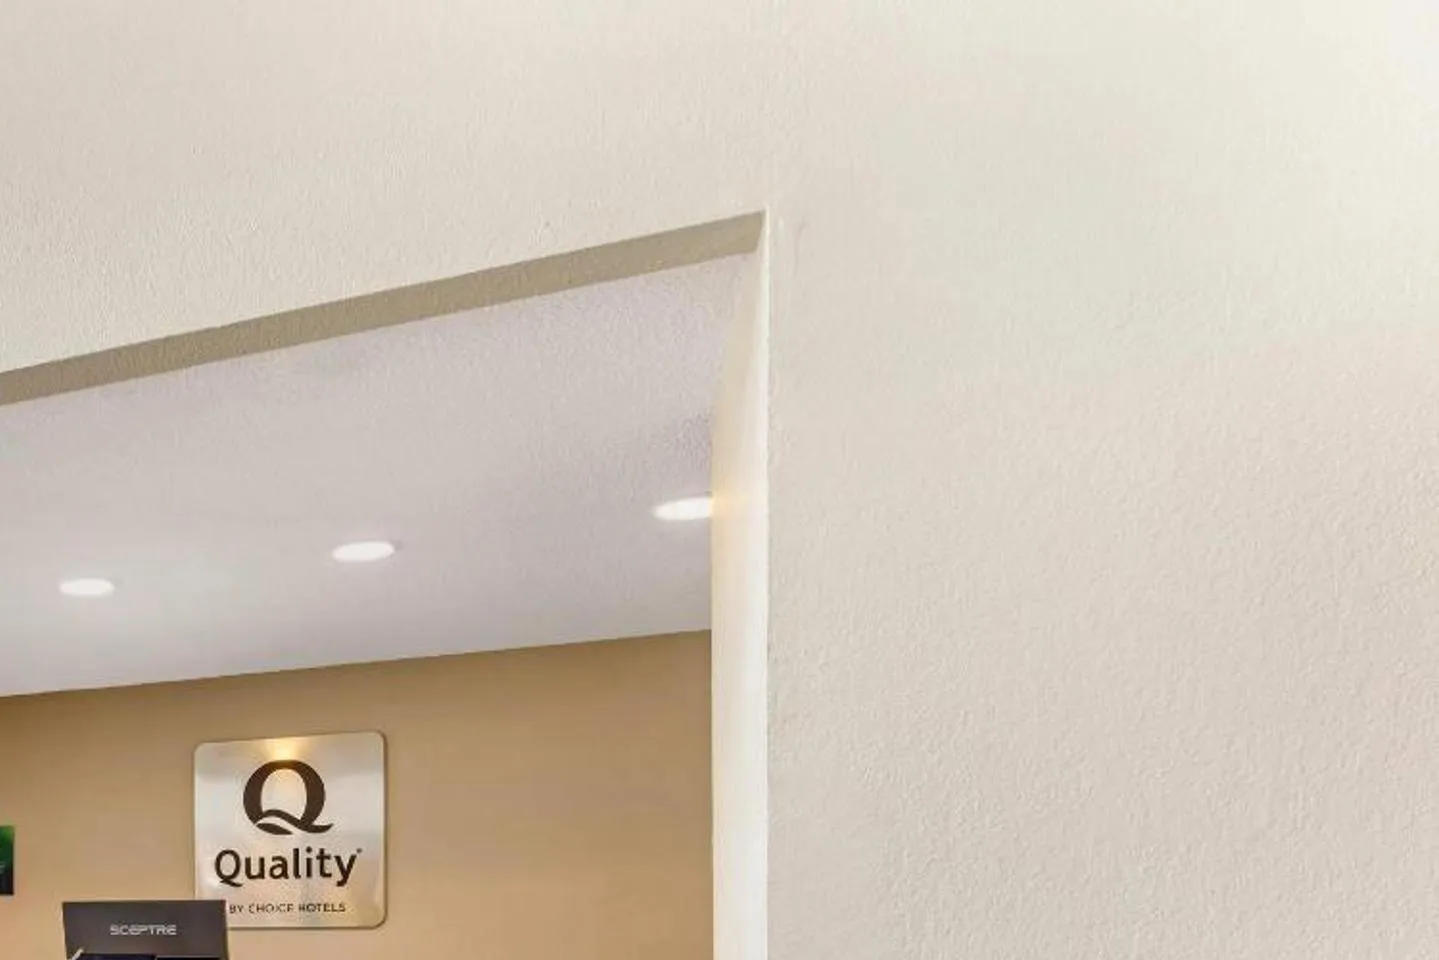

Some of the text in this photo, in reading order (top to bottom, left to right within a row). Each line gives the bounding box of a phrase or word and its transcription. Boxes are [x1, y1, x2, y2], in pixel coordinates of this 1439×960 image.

[243, 759, 335, 835] Q
[214, 846, 358, 887] Quality
[229, 902, 346, 914] BY CHOICE HOTELS
[110, 924, 178, 936] SCEPTRE
